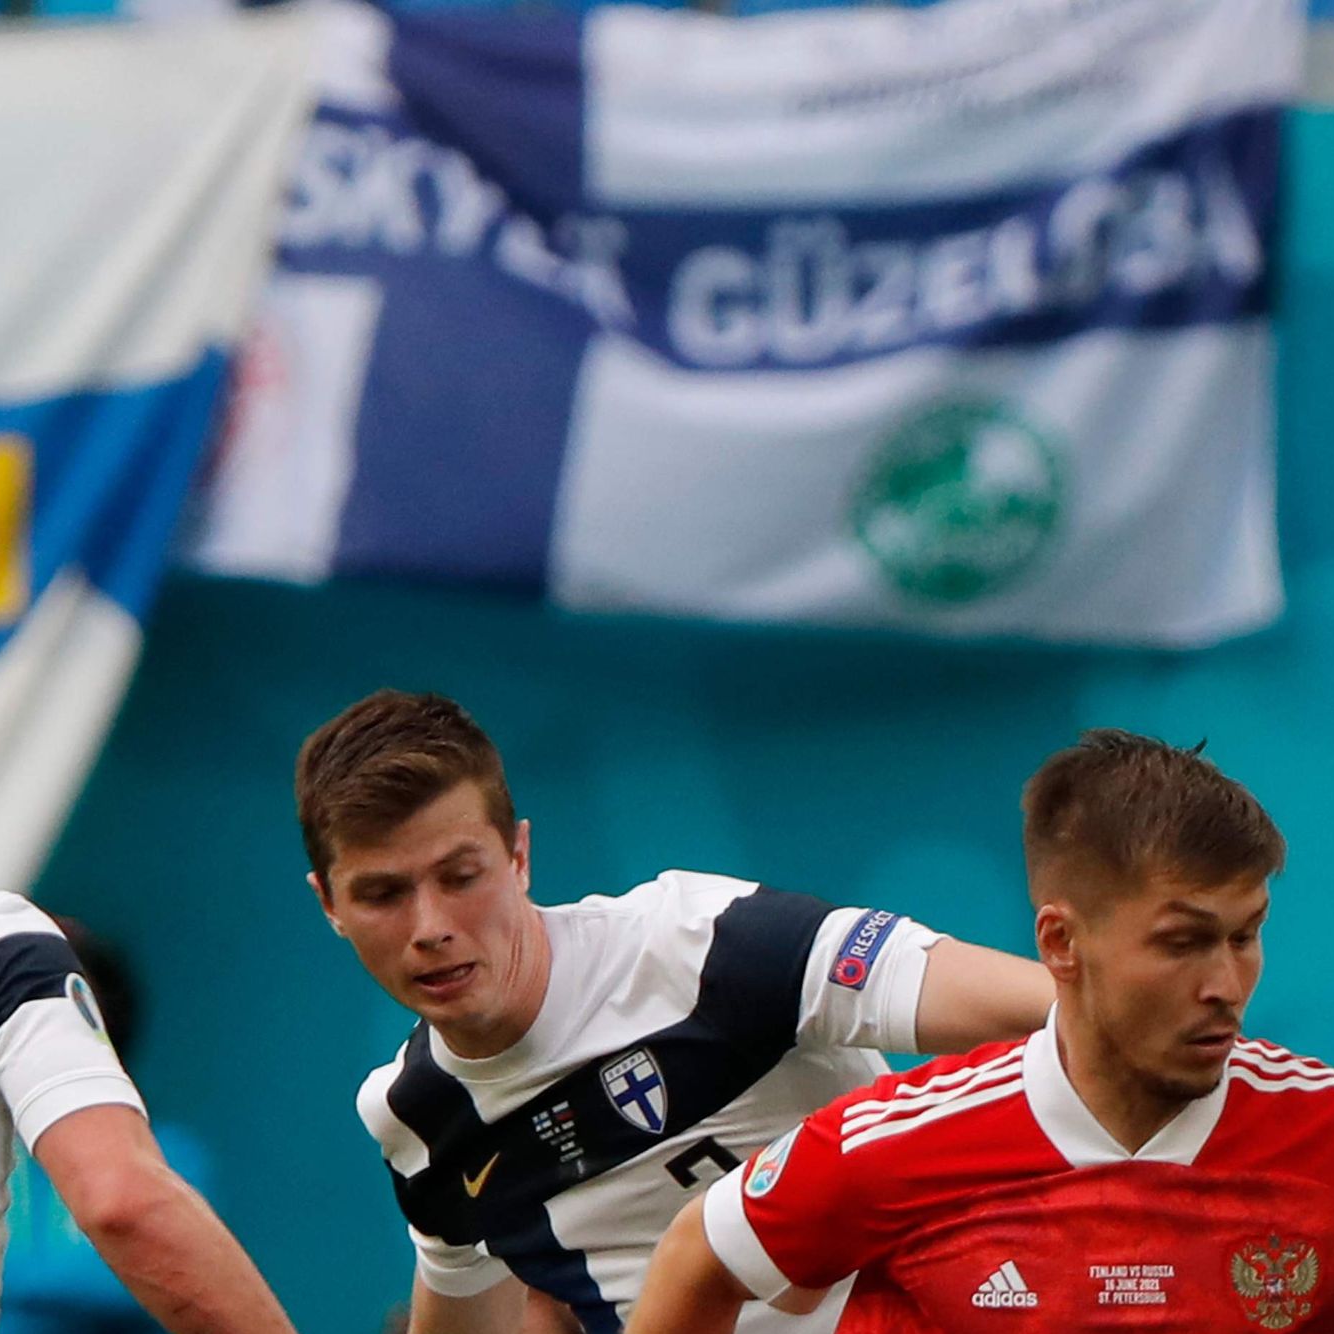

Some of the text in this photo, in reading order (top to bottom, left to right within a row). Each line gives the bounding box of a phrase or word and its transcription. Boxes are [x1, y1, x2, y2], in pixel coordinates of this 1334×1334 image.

[1089, 1264, 1175, 1278] FINLAND VS RUSSIA
[1105, 1278, 1115, 1290] 16
[1116, 1278, 1138, 1290] JUNE
[971, 1290, 1038, 1308] adidas
[1113, 1291, 1167, 1304] PETERSBURG
